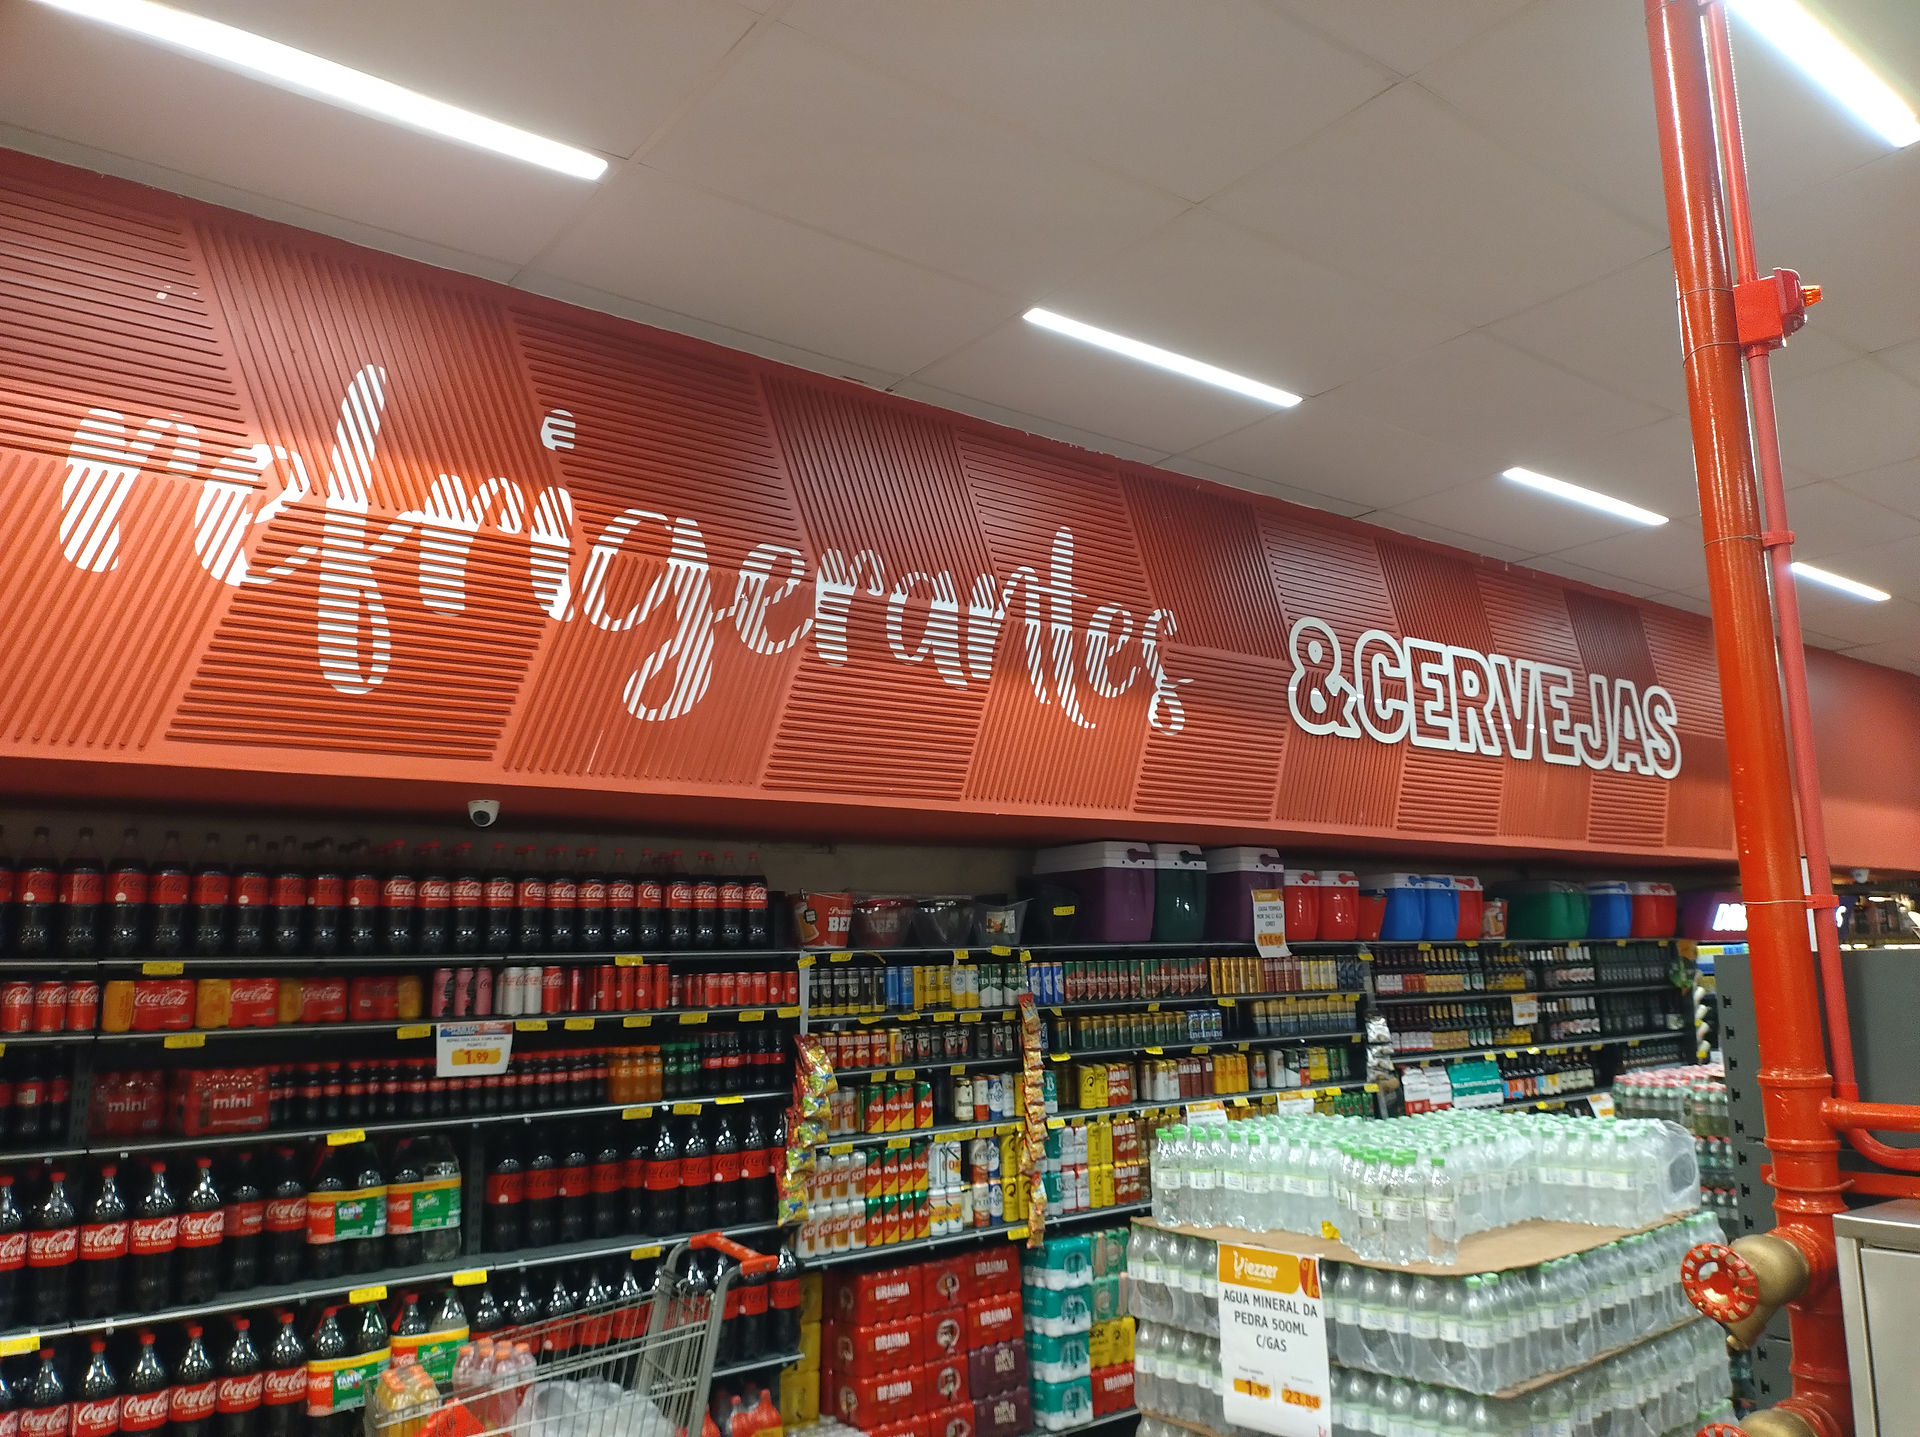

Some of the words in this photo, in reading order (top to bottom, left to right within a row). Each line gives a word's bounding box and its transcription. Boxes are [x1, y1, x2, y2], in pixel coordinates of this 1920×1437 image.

[108, 1098, 148, 1112] mini
[213, 1093, 251, 1109] mini
[1223, 1289, 1249, 1305] AGUA
[1252, 1294, 1300, 1315] MINERAL
[1303, 1303, 1318, 1318] DA
[1234, 1310, 1268, 1329] PEDRA
[1272, 1318, 1308, 1337] 500ML
[1256, 1334, 1287, 1352] C/GAS
